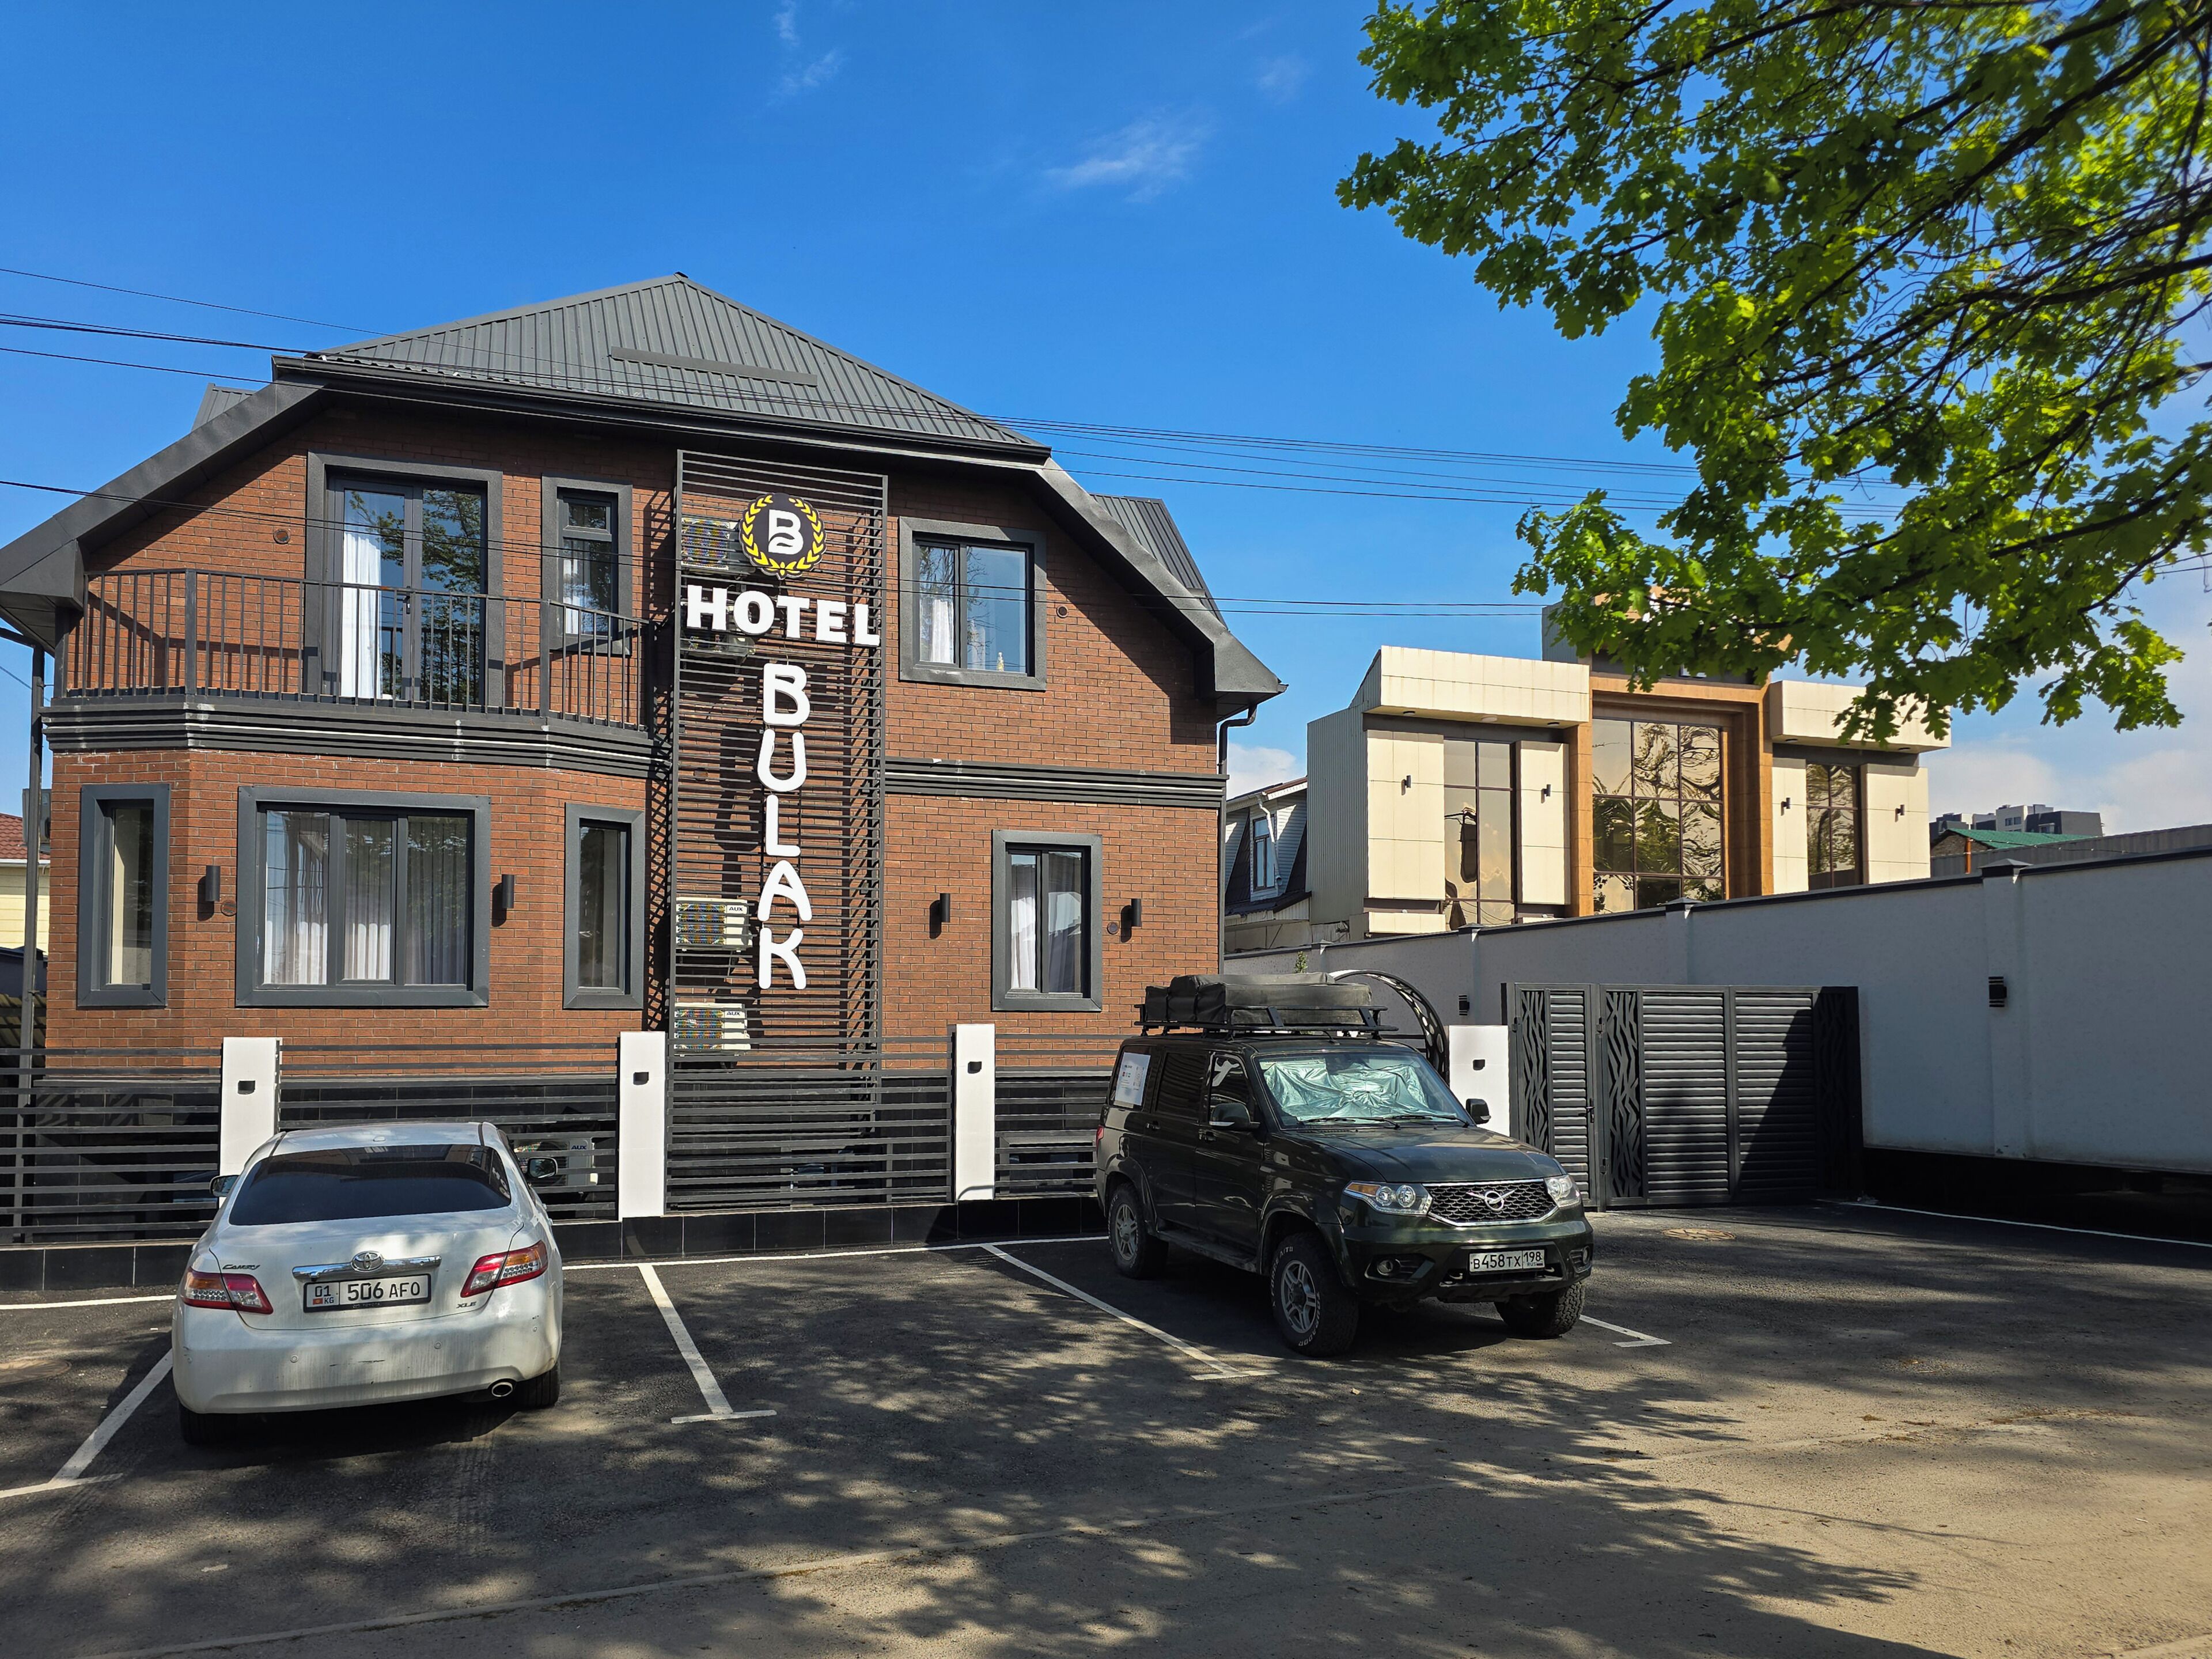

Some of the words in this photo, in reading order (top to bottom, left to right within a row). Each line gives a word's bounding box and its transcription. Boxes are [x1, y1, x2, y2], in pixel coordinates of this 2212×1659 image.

[687, 585, 880, 646] HOTEL
[757, 662, 812, 990] BULAK
[1524, 1251, 1541, 1262] 198
[315, 1285, 331, 1297] 01
[347, 1282, 384, 1301] 506
